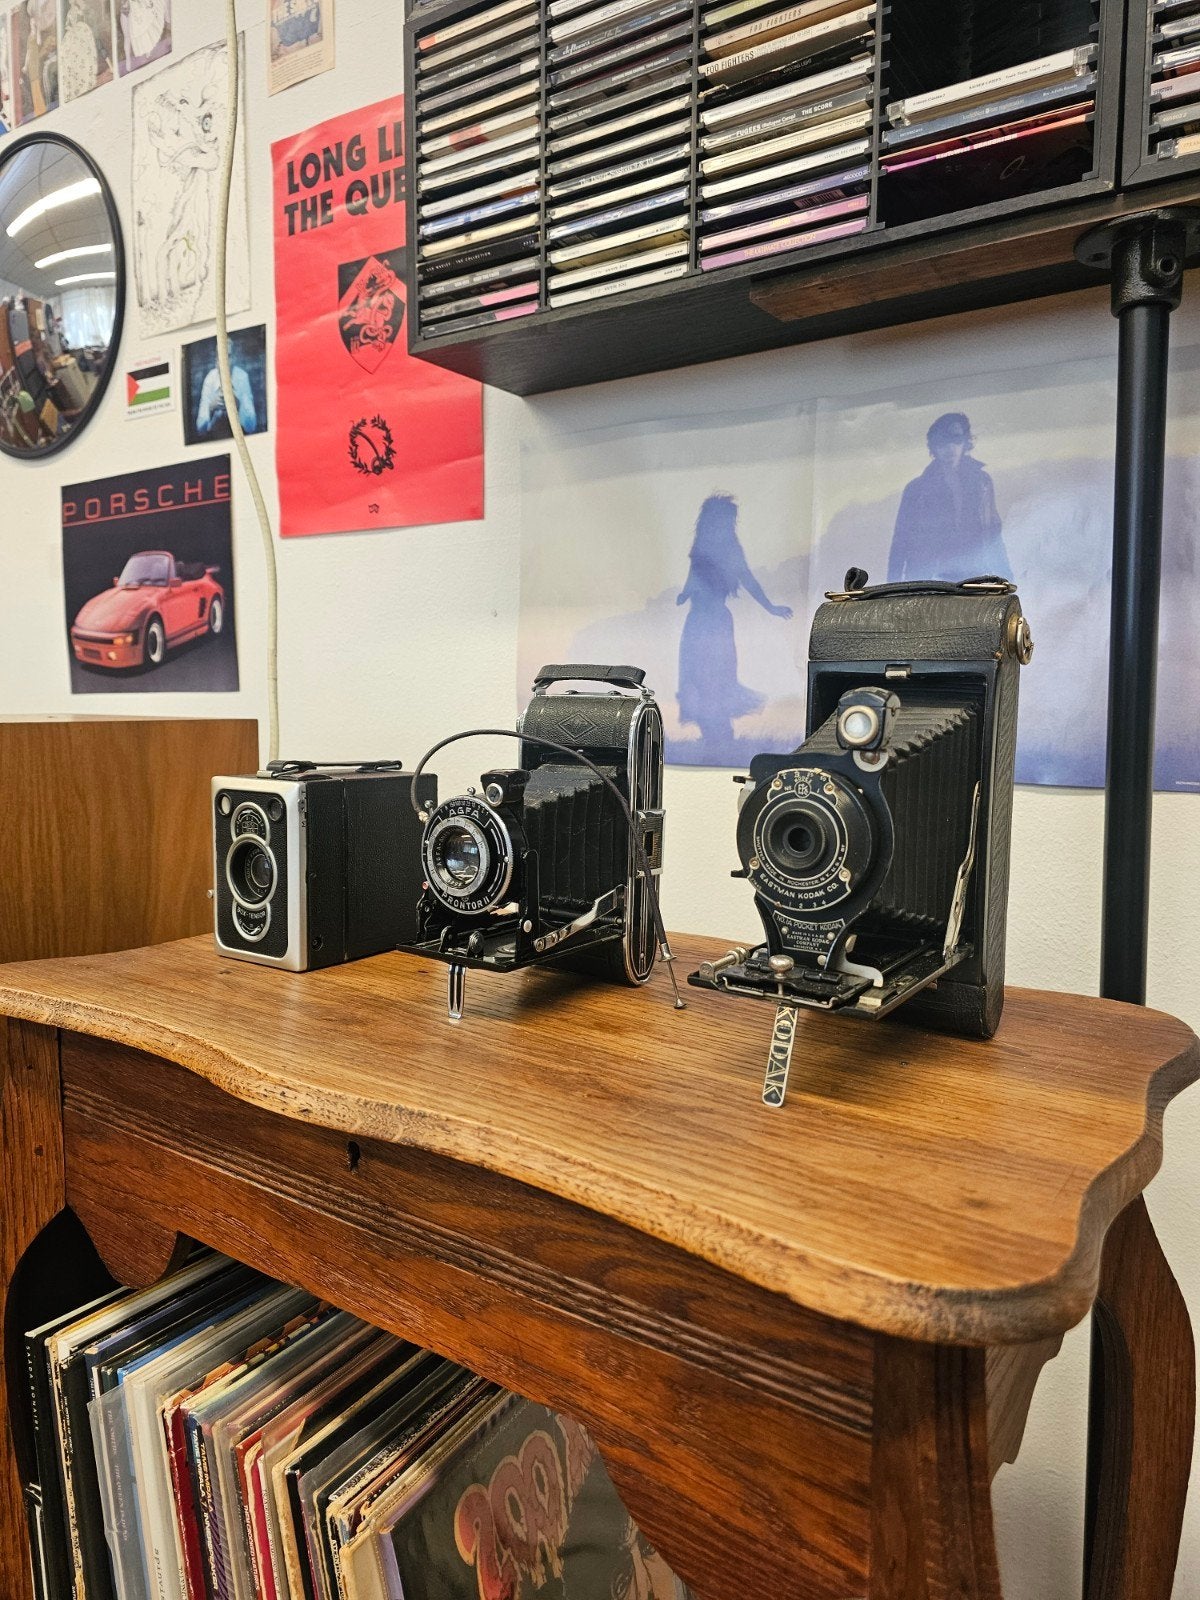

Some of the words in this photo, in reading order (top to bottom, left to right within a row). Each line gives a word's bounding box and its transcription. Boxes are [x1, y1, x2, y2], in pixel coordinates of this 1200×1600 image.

[749, 19, 765, 32] FOO
[766, 8, 802, 28] FIGHTERS
[706, 61, 719, 75] FOO
[721, 50, 755, 71] FIGHTERS
[736, 124, 761, 137] FUGEES
[762, 117, 781, 130] (Refugee
[782, 113, 796, 124] Camp)
[801, 107, 813, 116] THE
[813, 101, 833, 114] SCORE
[287, 134, 367, 195] LONG
[378, 121, 403, 163] LI
[284, 189, 333, 236] THE
[345, 166, 405, 216] QUE
[63, 474, 230, 522] PORSCHE
[449, 806, 479, 818] AGFA
[442, 892, 483, 911] PRONTOR
[760, 873, 796, 898] EASTMAN
[798, 889, 826, 899] KODAK
[827, 882, 840, 892] CO.
[787, 934, 811, 942] EASTMAN
[794, 921, 819, 931] POCKET
[820, 922, 842, 931] KODAK
[796, 940, 819, 948] COMPANY
[763, 1006, 797, 1101] KODAK
[25, 1345, 34, 1378] SAADA
[30, 1385, 40, 1431] BONAIRE
[200, 1442, 208, 1471] TAME
[204, 1472, 213, 1512] IMPALA
[192, 1429, 200, 1457] TAME
[196, 1459, 206, 1497] IMPALA
[202, 1510, 219, 1590] INNERSPEAKER
[246, 1523, 255, 1555] CROOKED
[251, 1556, 261, 1590] VULTURES
